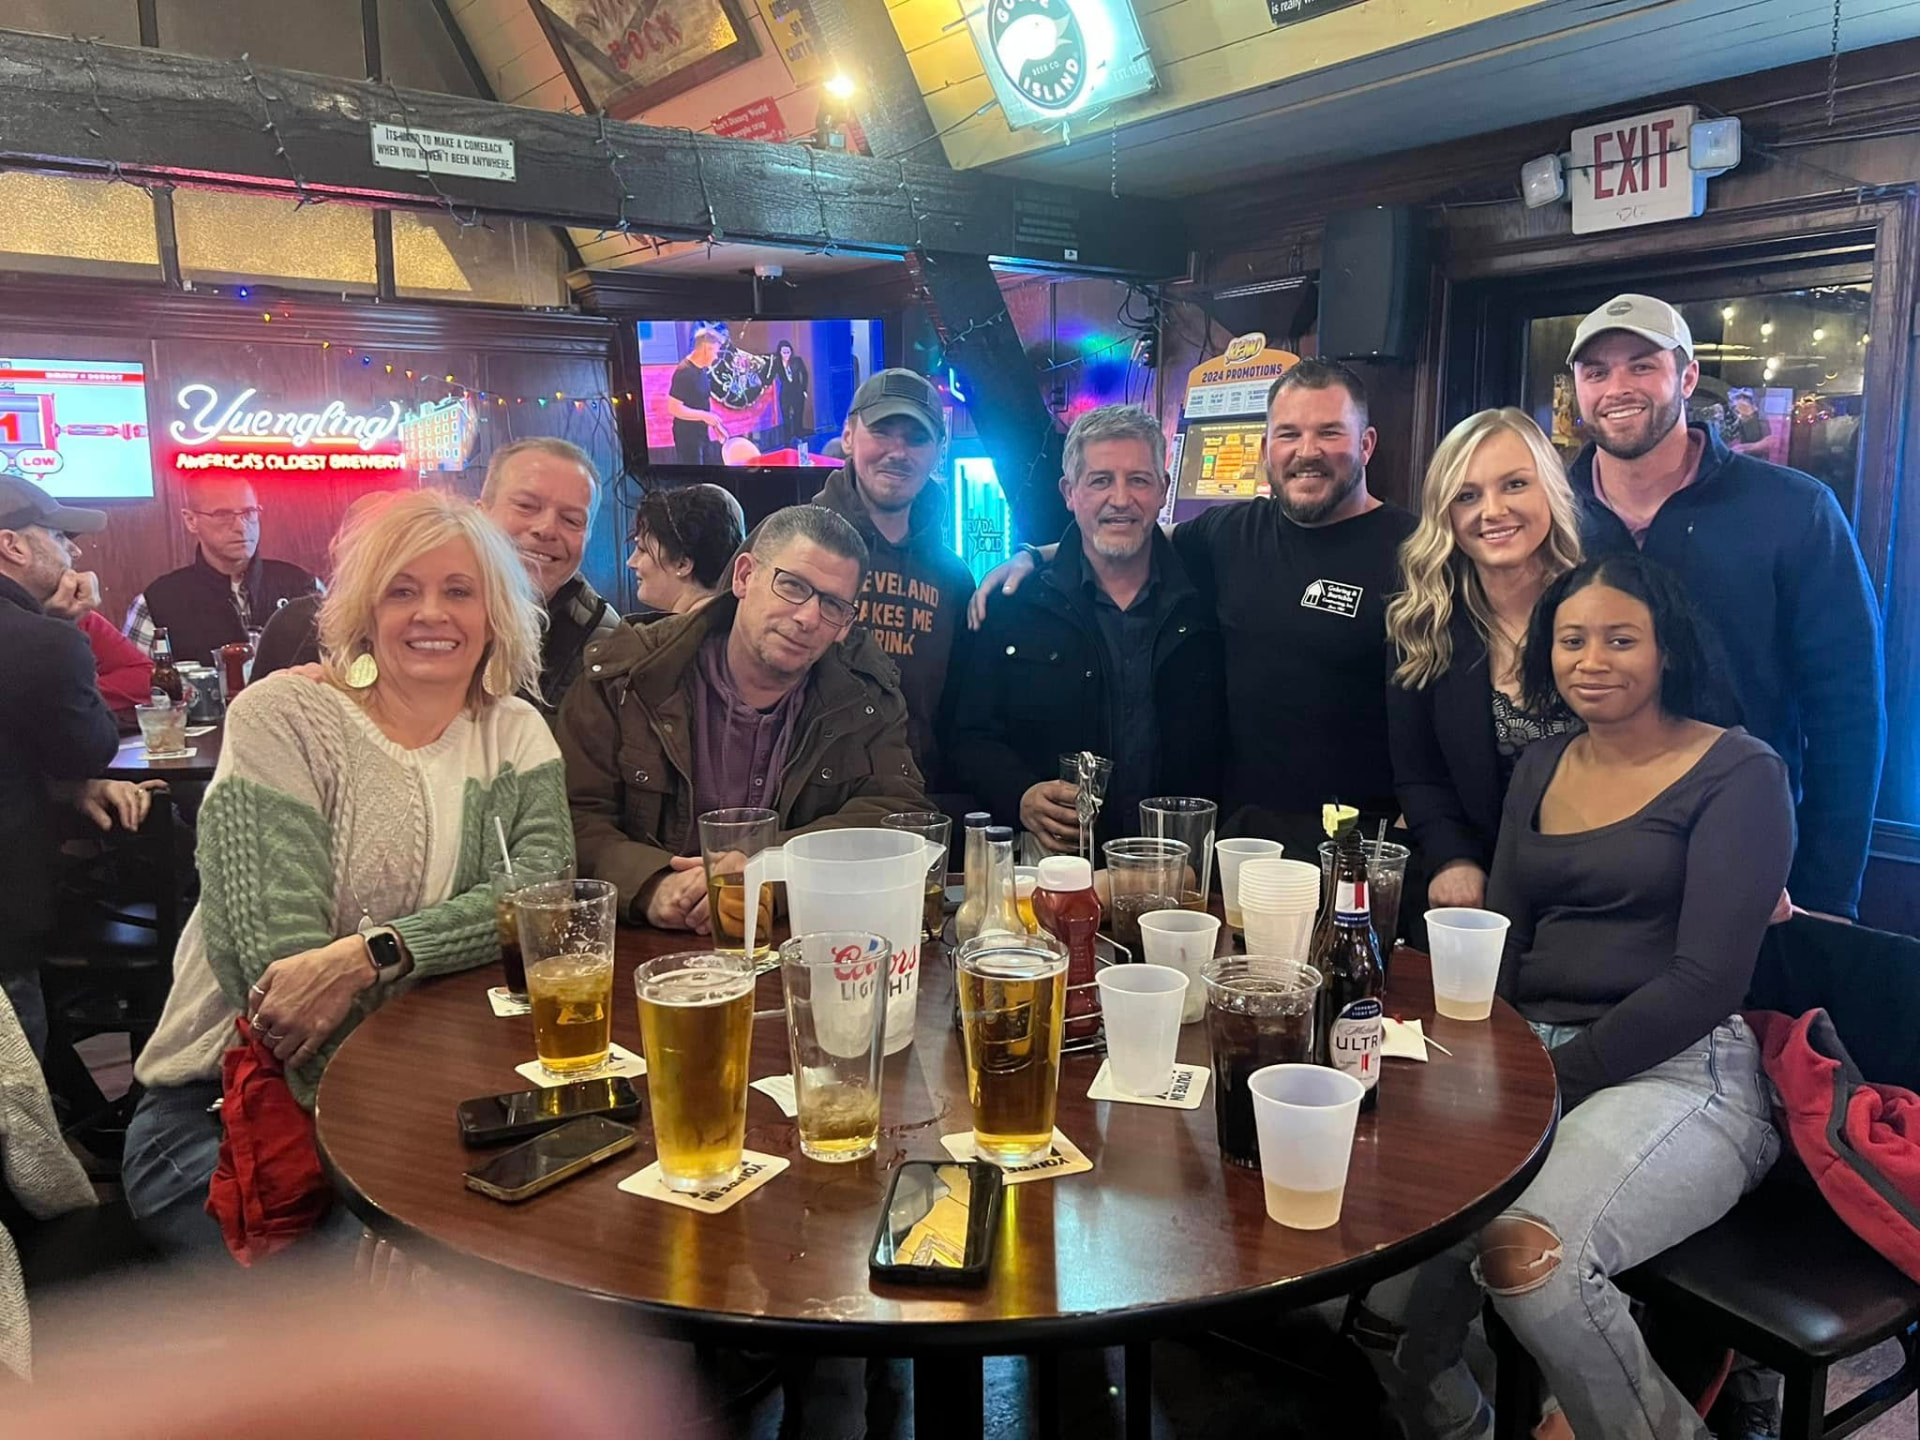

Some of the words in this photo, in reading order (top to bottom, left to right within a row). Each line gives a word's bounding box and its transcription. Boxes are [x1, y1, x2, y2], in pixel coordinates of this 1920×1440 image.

[1271, 1, 1279, 15] is
[1280, 0, 1301, 12] really
[1022, 57, 1080, 101] ISLAND
[376, 143, 400, 157] WHEN
[402, 147, 417, 158] YOU
[451, 152, 470, 165] BEEN
[422, 134, 432, 145] TO
[434, 135, 454, 148] MAKE
[457, 138, 462, 149] A
[464, 139, 503, 154] COMEBACK
[1593, 119, 1675, 200] EXIT
[1201, 371, 1224, 384] 2024
[1225, 363, 1283, 381] PROMOTIONS
[169, 384, 402, 450] Yuengling
[23, 457, 56, 466] LOW
[266, 454, 327, 471] OLDEST
[861, 570, 939, 608] EVELAND
[858, 600, 906, 629] AKES
[911, 607, 934, 633] ME
[871, 628, 916, 656] RINK
[840, 971, 913, 1001] LIGHT
[1335, 1034, 1379, 1051] ULTR
